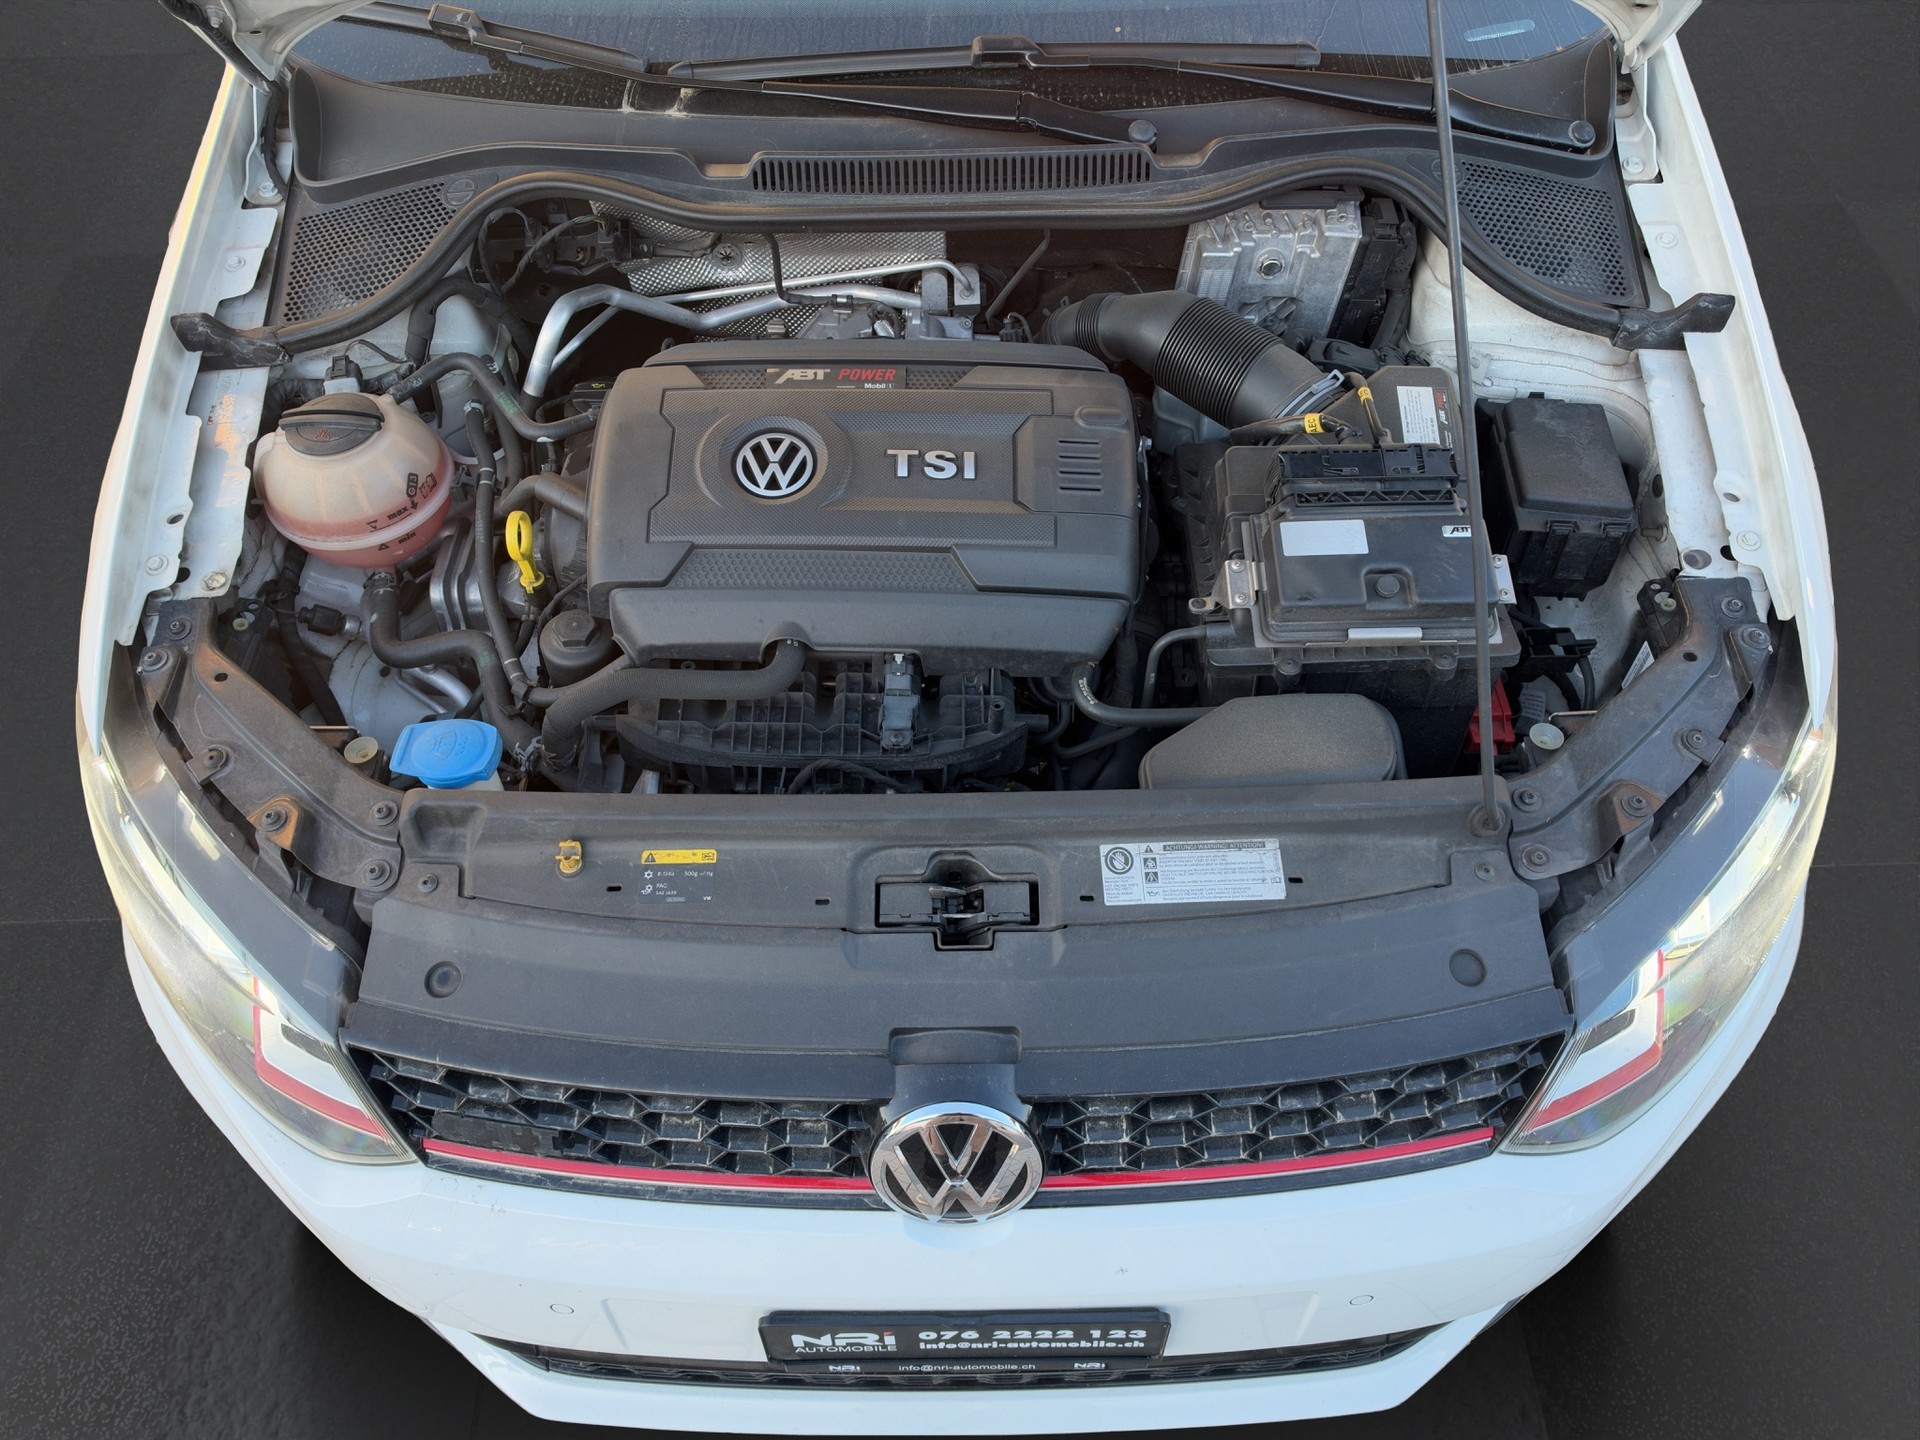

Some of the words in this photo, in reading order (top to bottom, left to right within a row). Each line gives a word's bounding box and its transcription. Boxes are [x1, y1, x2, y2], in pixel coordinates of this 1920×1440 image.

[774, 368, 831, 384] ABT
[837, 368, 896, 381] POWER
[1307, 417, 1317, 433] AEC
[886, 449, 976, 479] TSI
[408, 475, 417, 496] G13
[387, 506, 409, 520] max
[1450, 526, 1471, 534] ABT
[398, 532, 416, 544] min
[918, 1331, 980, 1340] 076
[991, 1330, 1074, 1339] 2222
[1090, 1329, 1147, 1339] 123
[795, 1345, 898, 1353] AUTOMOBILE
[919, 1340, 1145, 1349] info@nri-automobile.ch
[899, 1363, 1036, 1372] info@nri-automobile.ch
